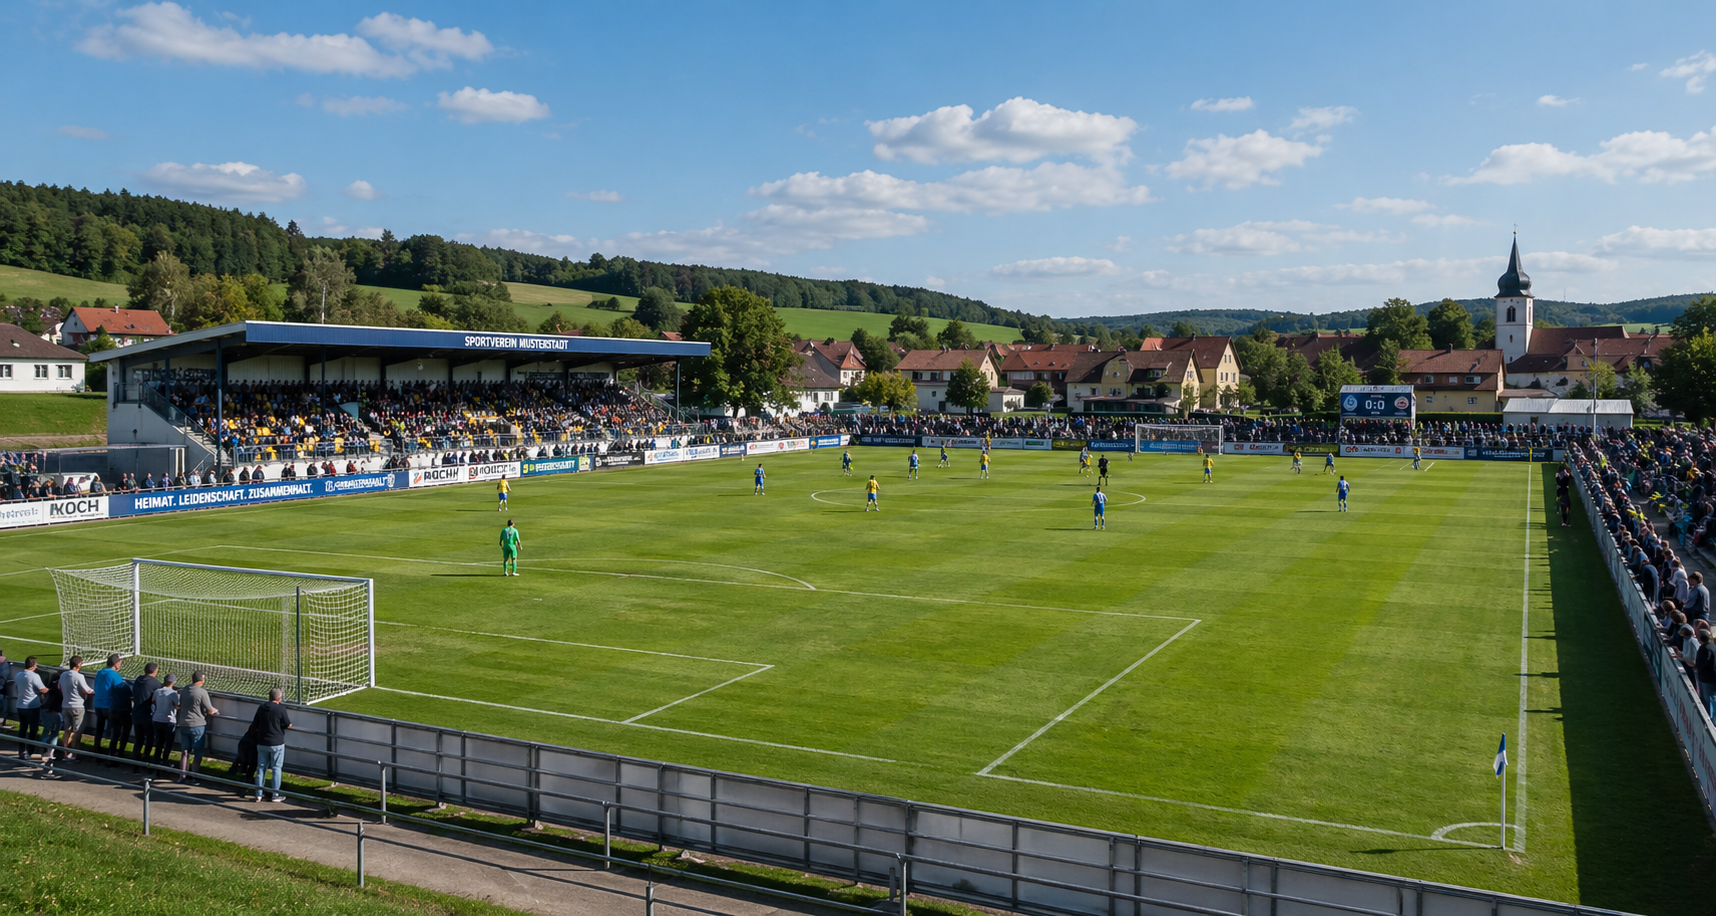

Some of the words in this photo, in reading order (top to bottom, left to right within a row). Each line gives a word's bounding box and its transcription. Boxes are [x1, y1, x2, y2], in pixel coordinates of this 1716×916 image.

[465, 336, 517, 349] SPORTVEREIN
[519, 338, 569, 350] MUSTERSTADT
[1365, 400, 1385, 410] 0:0
[134, 495, 177, 510] HEIMAT.
[179, 489, 247, 506] LEIDENSCHAFT.
